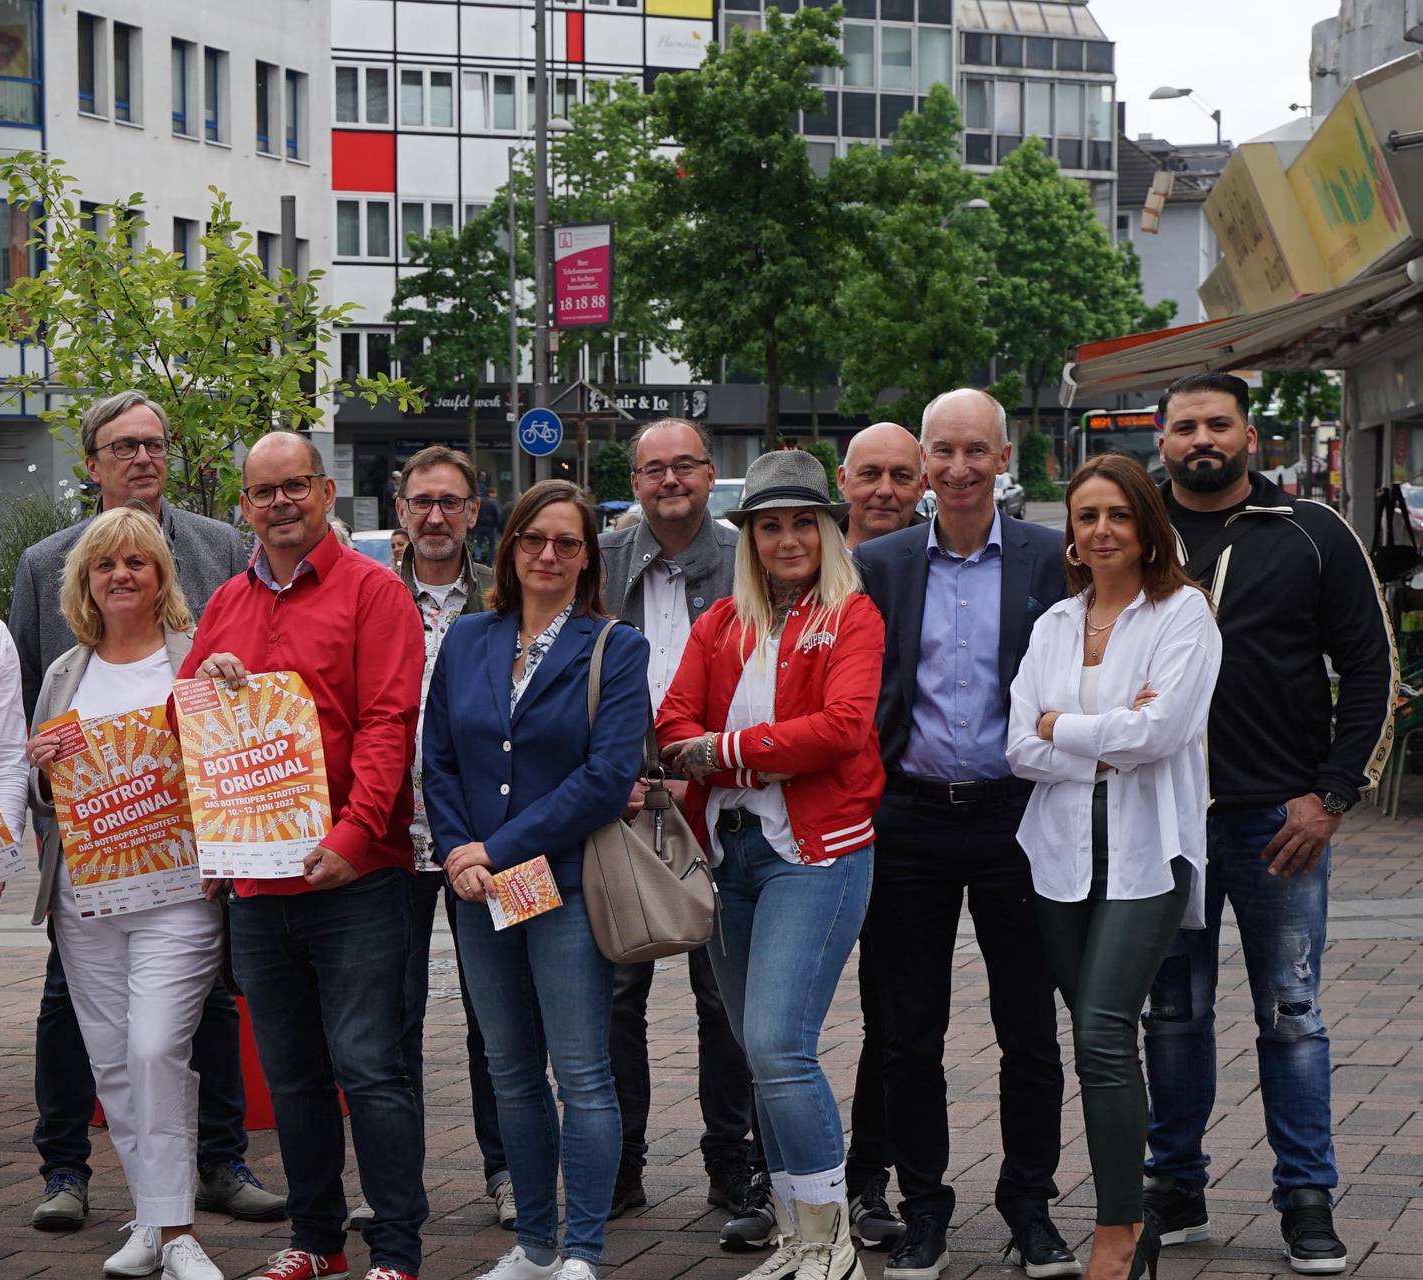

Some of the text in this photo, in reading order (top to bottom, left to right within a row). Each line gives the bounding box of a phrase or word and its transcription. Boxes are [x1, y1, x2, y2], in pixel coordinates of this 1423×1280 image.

[560, 294, 606, 311] 18 18 88
[639, 395, 651, 409] &
[203, 739, 289, 777] BOTTROP
[220, 757, 308, 795] ORIGINAL
[74, 774, 156, 820] BOTTROP
[93, 790, 178, 834] ORIGINAL
[204, 784, 311, 809] DAS BOTTROPER STADTFEST
[227, 808, 238, 816] 10.
[243, 806, 255, 814] 12.
[256, 803, 274, 813] JUNI
[275, 799, 294, 809] 2022
[78, 815, 180, 853] DAS BOTTROPER STADTFEST
[103, 846, 114, 855] 10.
[119, 841, 129, 849] 12.
[130, 836, 146, 848] JUNI
[148, 830, 166, 841] 2022
[510, 880, 529, 912] ORIGINAL
[514, 872, 534, 903] BOTTROP
